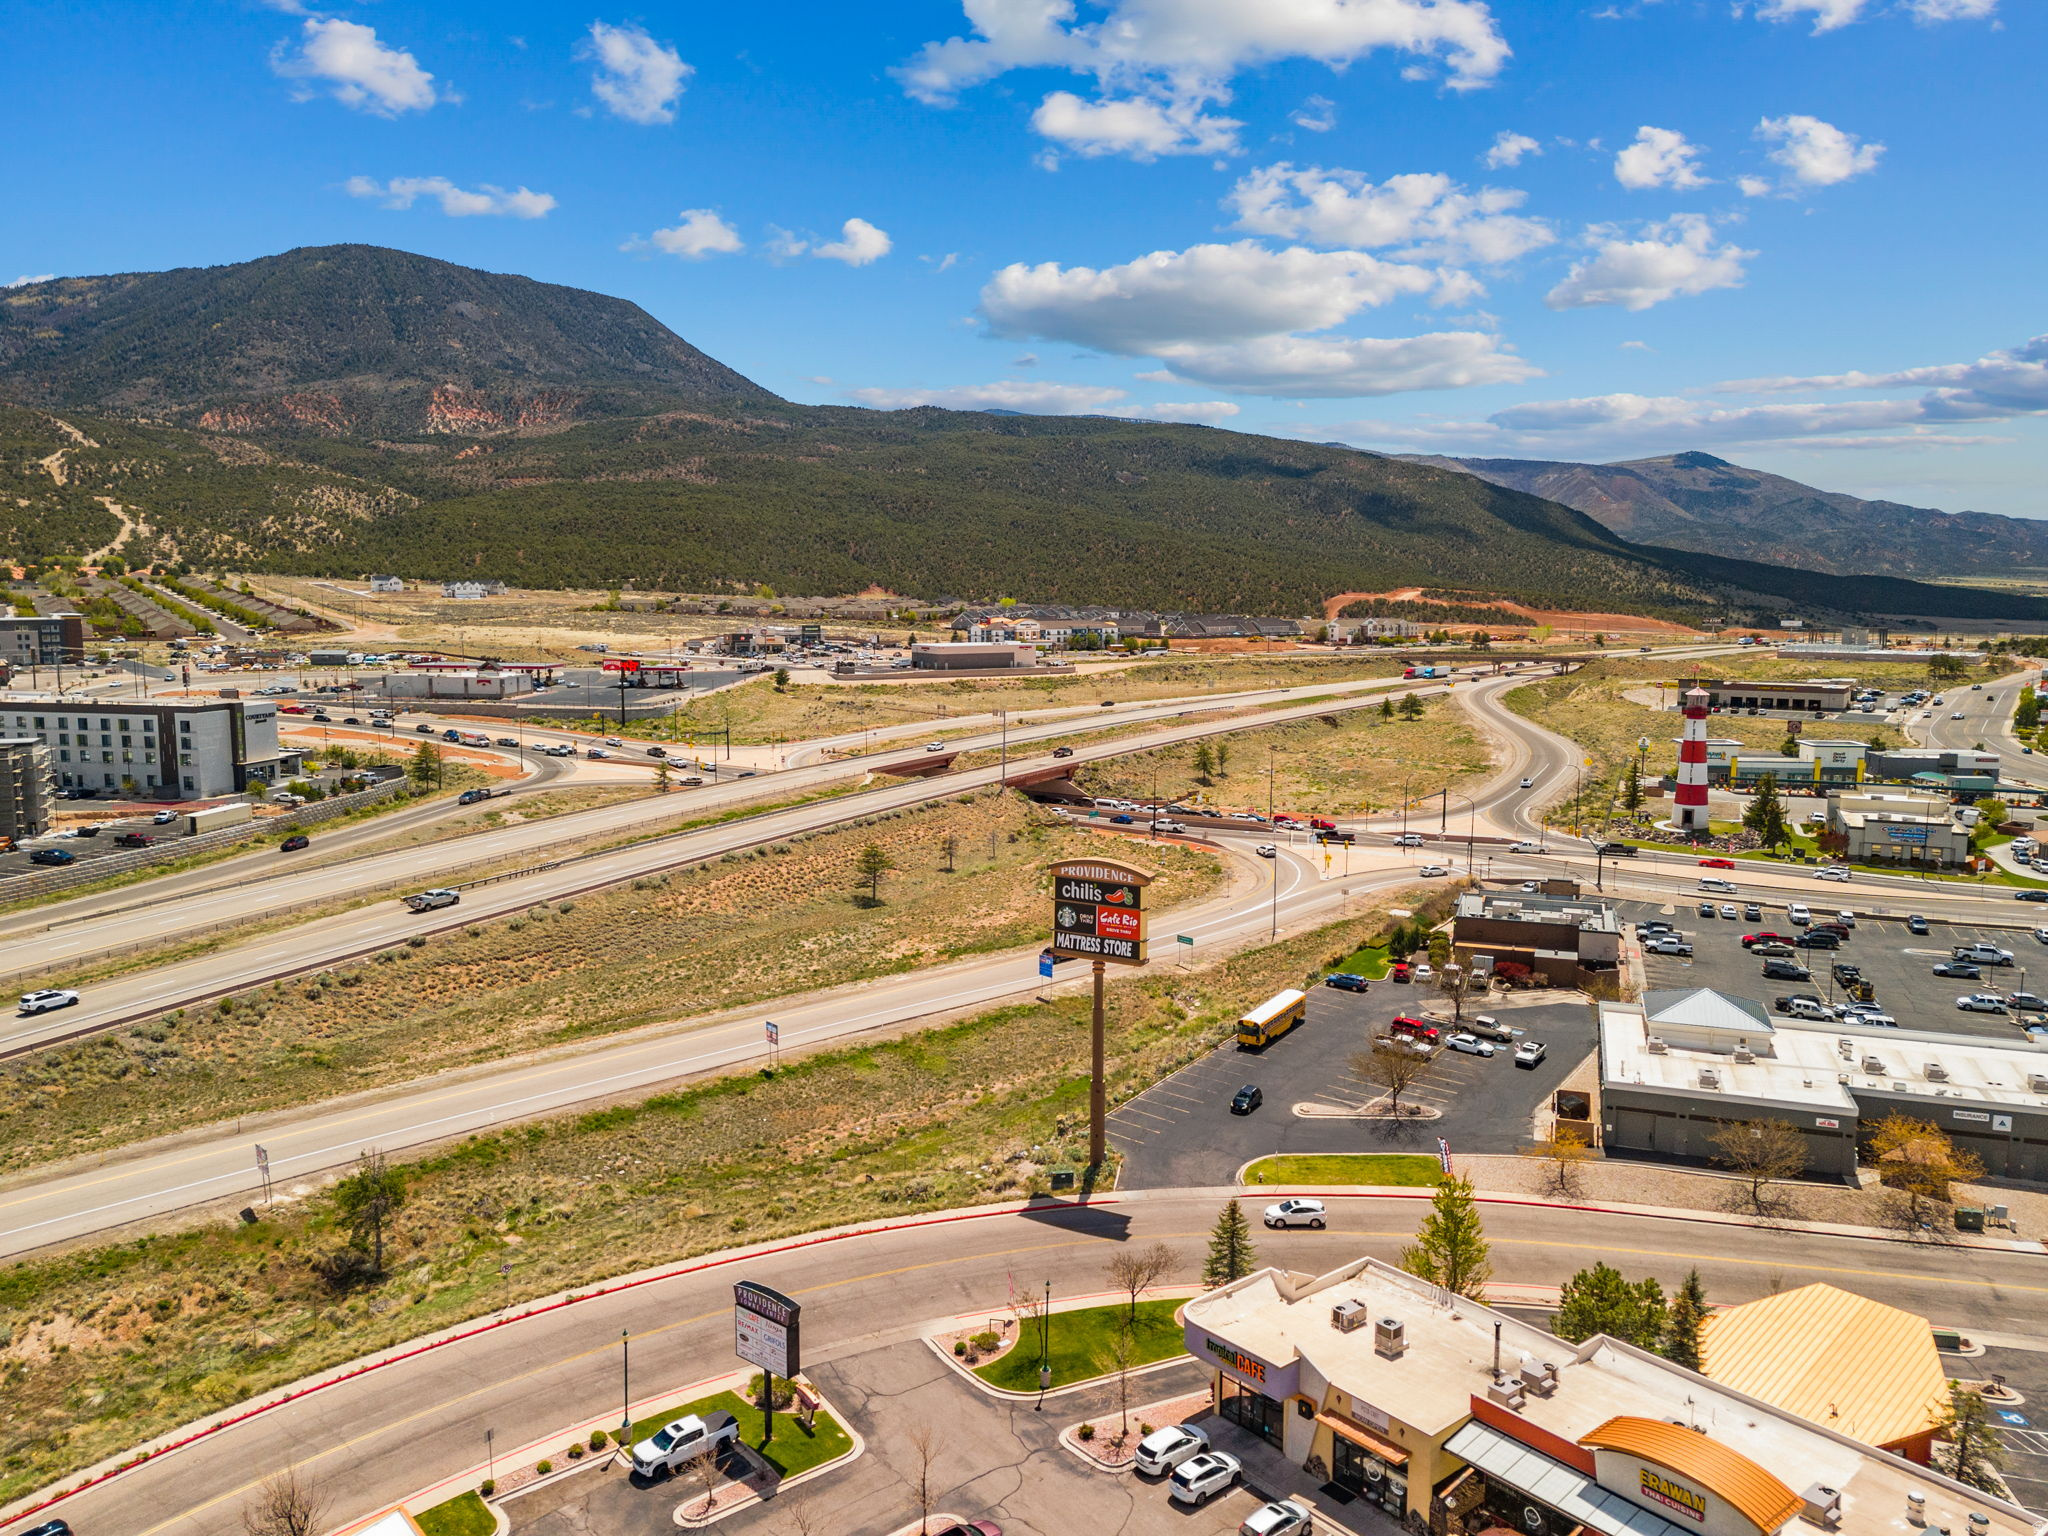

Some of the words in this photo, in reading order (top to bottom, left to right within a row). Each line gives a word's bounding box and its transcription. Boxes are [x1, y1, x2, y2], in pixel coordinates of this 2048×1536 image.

[246, 712, 275, 720] COURTYARD
[1061, 866, 1134, 883] PROVIDENCE
[1062, 881, 1102, 901] chili's
[1100, 912, 1120, 925] Cafe
[1122, 914, 1138, 926] Rio
[1056, 932, 1100, 953] MATTRESS
[1103, 938, 1133, 957] STORE
[1954, 1111, 1988, 1120] INSURANCE
[737, 1287, 786, 1317] PROVIDENCE
[737, 1320, 759, 1334] RE/MAX
[1237, 1354, 1265, 1383] CAFE
[1640, 1468, 1705, 1512] ERAWAN
[1644, 1487, 1664, 1503] THAI
[1664, 1498, 1701, 1519] CUISINE
